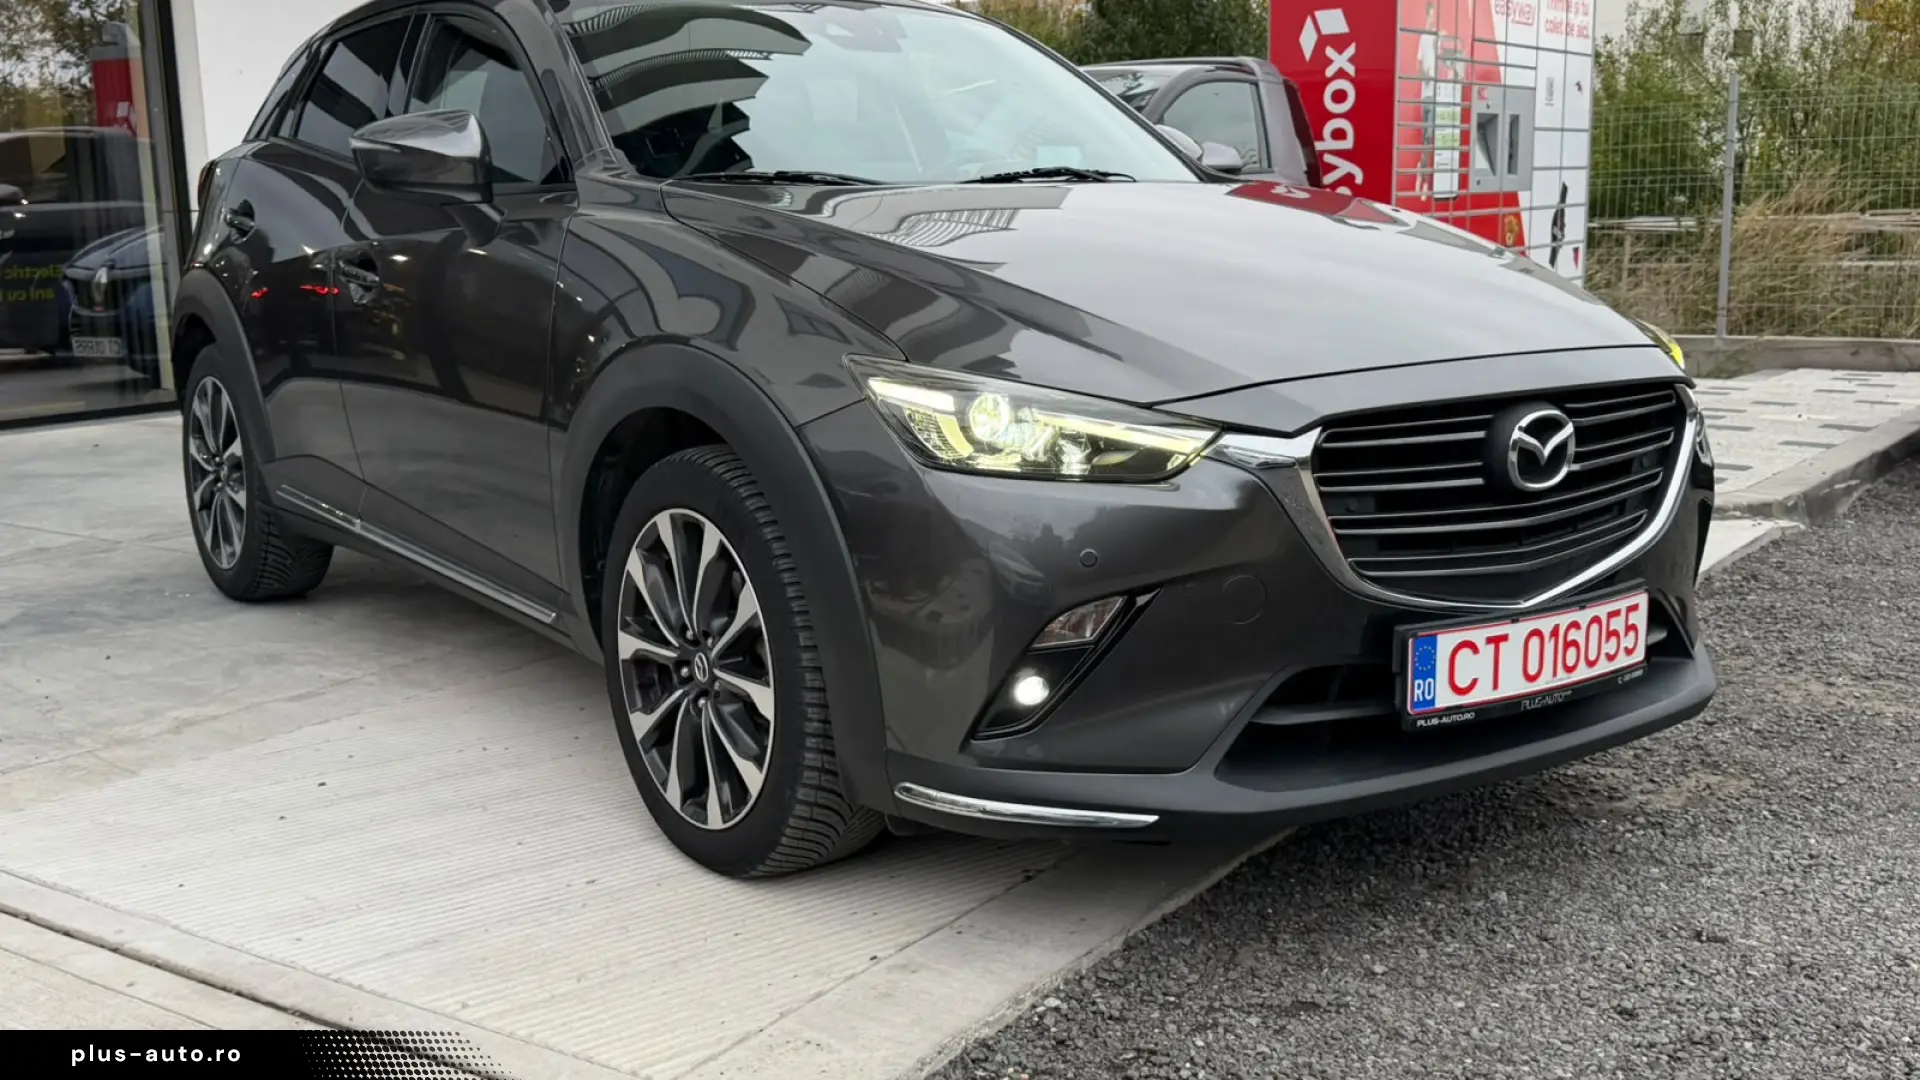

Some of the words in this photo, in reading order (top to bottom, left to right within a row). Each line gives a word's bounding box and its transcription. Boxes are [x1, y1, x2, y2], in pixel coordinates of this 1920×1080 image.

[1448, 633, 1509, 696] CT
[1522, 603, 1640, 683] 016055
[1414, 678, 1434, 701] RO
[1417, 711, 1476, 727] PLUS-AUTO.RO
